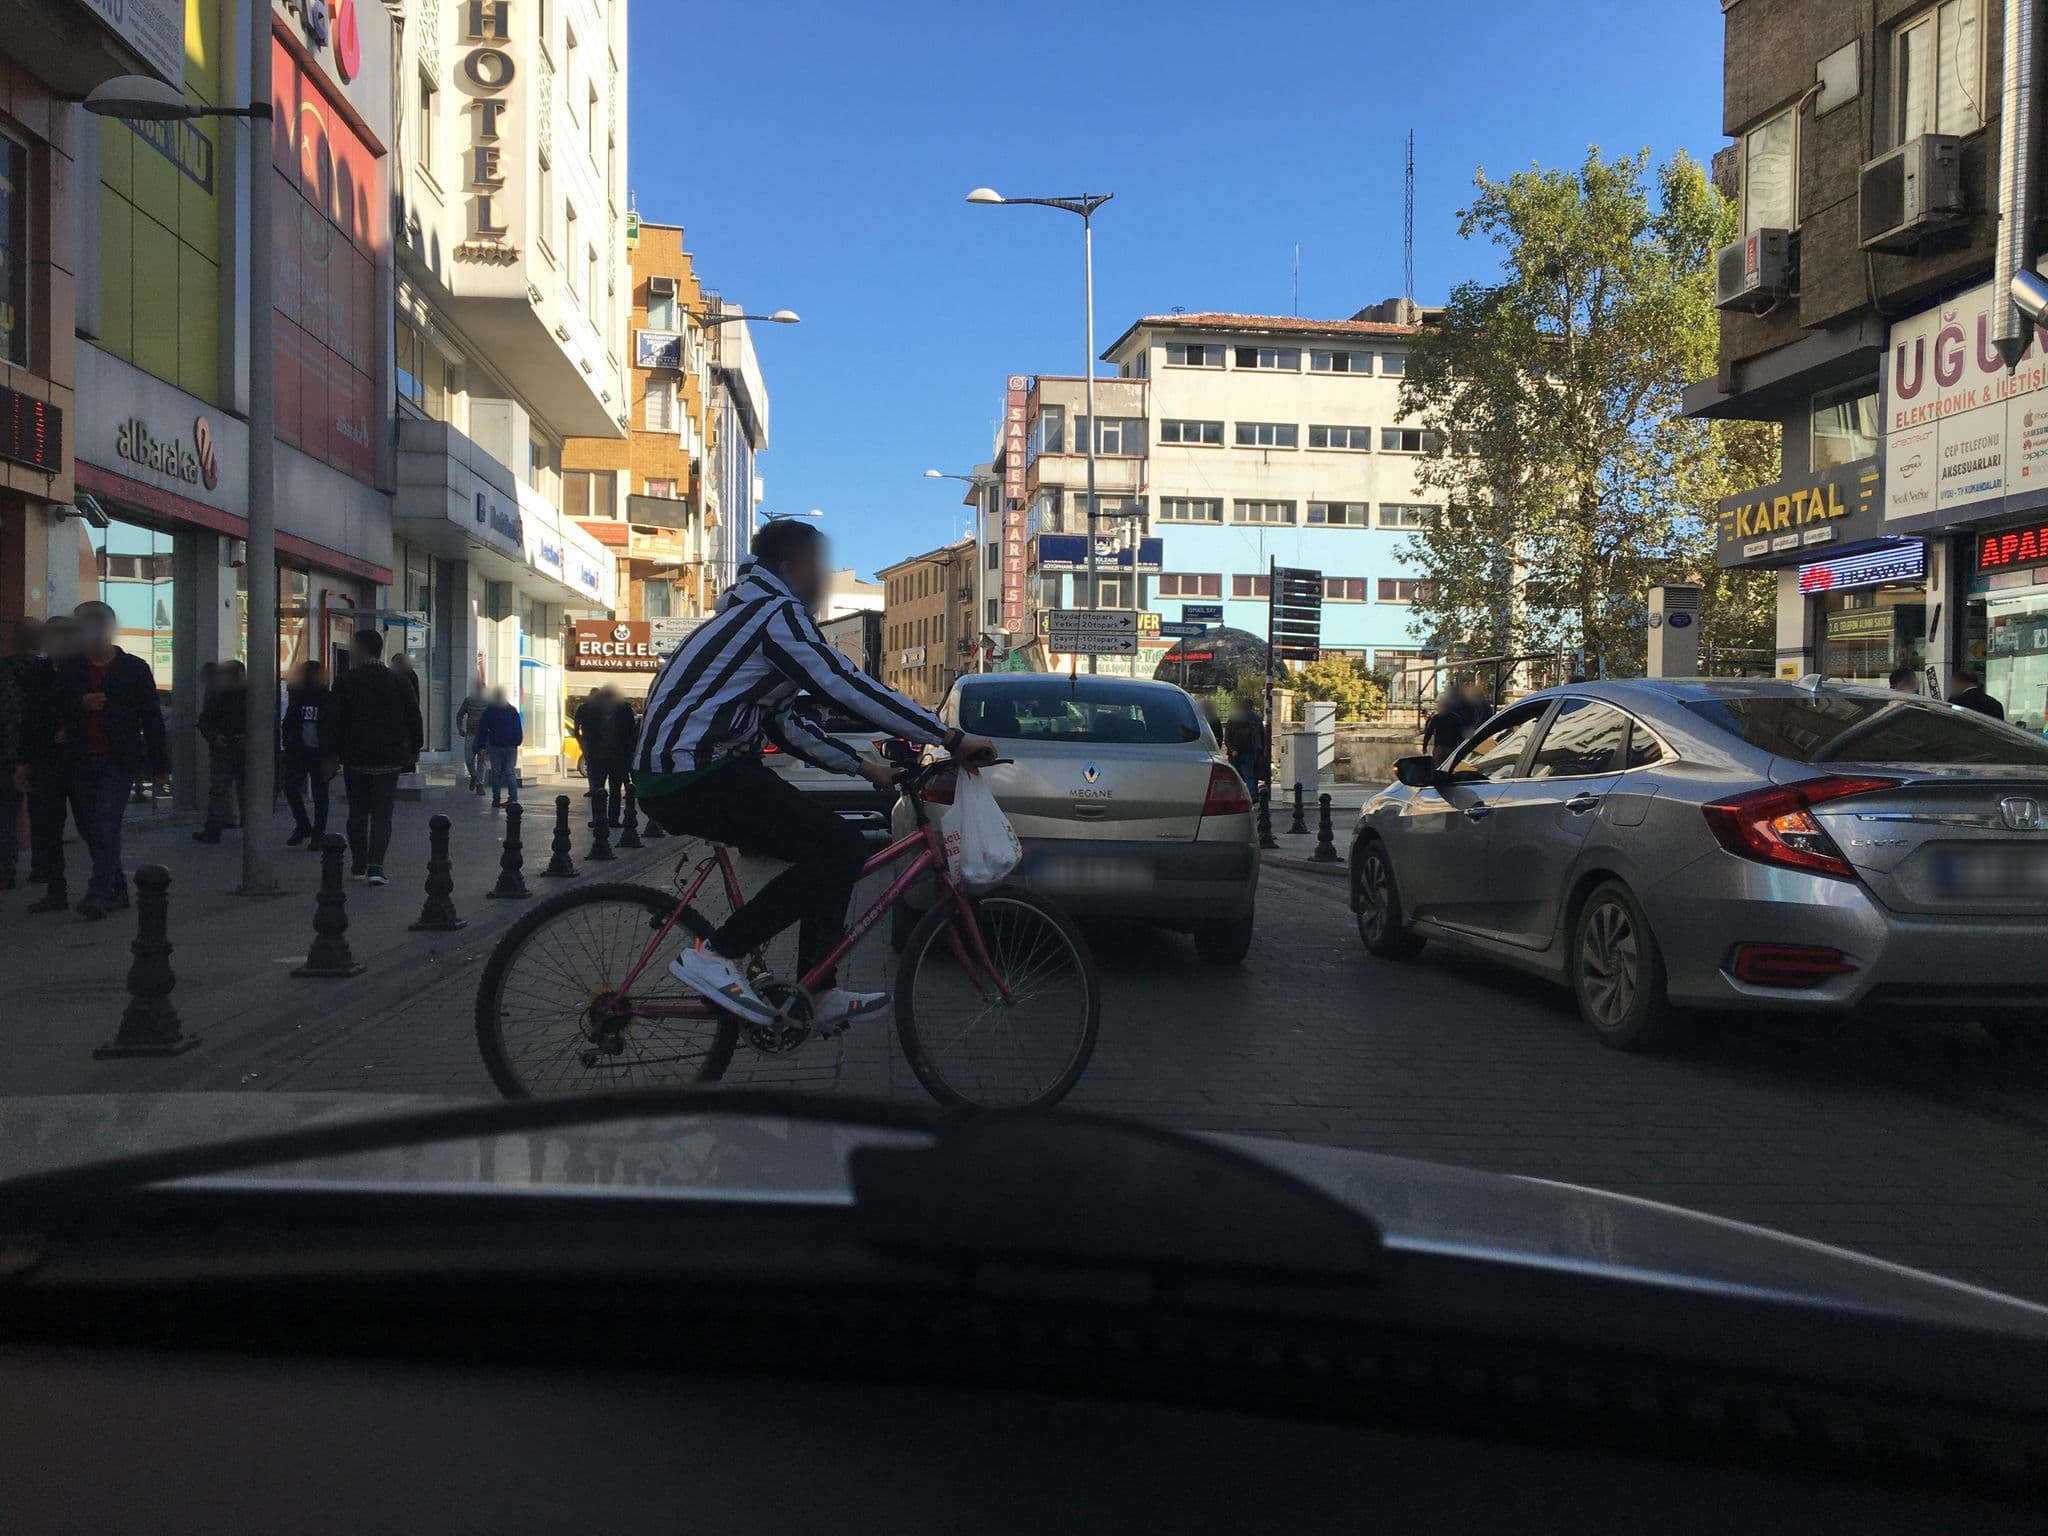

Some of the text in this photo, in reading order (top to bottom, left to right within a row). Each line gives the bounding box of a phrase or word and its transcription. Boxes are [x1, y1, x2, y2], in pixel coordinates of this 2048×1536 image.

[463, 0, 515, 235] HOTEL
[1896, 389, 1977, 429] ELEKTRONİK
[1996, 363, 2048, 399] İLETİŞİ
[1009, 407, 1023, 498] SAADET
[1944, 433, 1999, 458] CEP TELEFONU
[1941, 453, 2001, 481] AKSESUARLARI
[1736, 483, 1845, 538] KARTAL
[580, 659, 623, 667] BAKLAVA
[635, 660, 658, 668] FISTI
[1069, 788, 1113, 799] MEGANE
